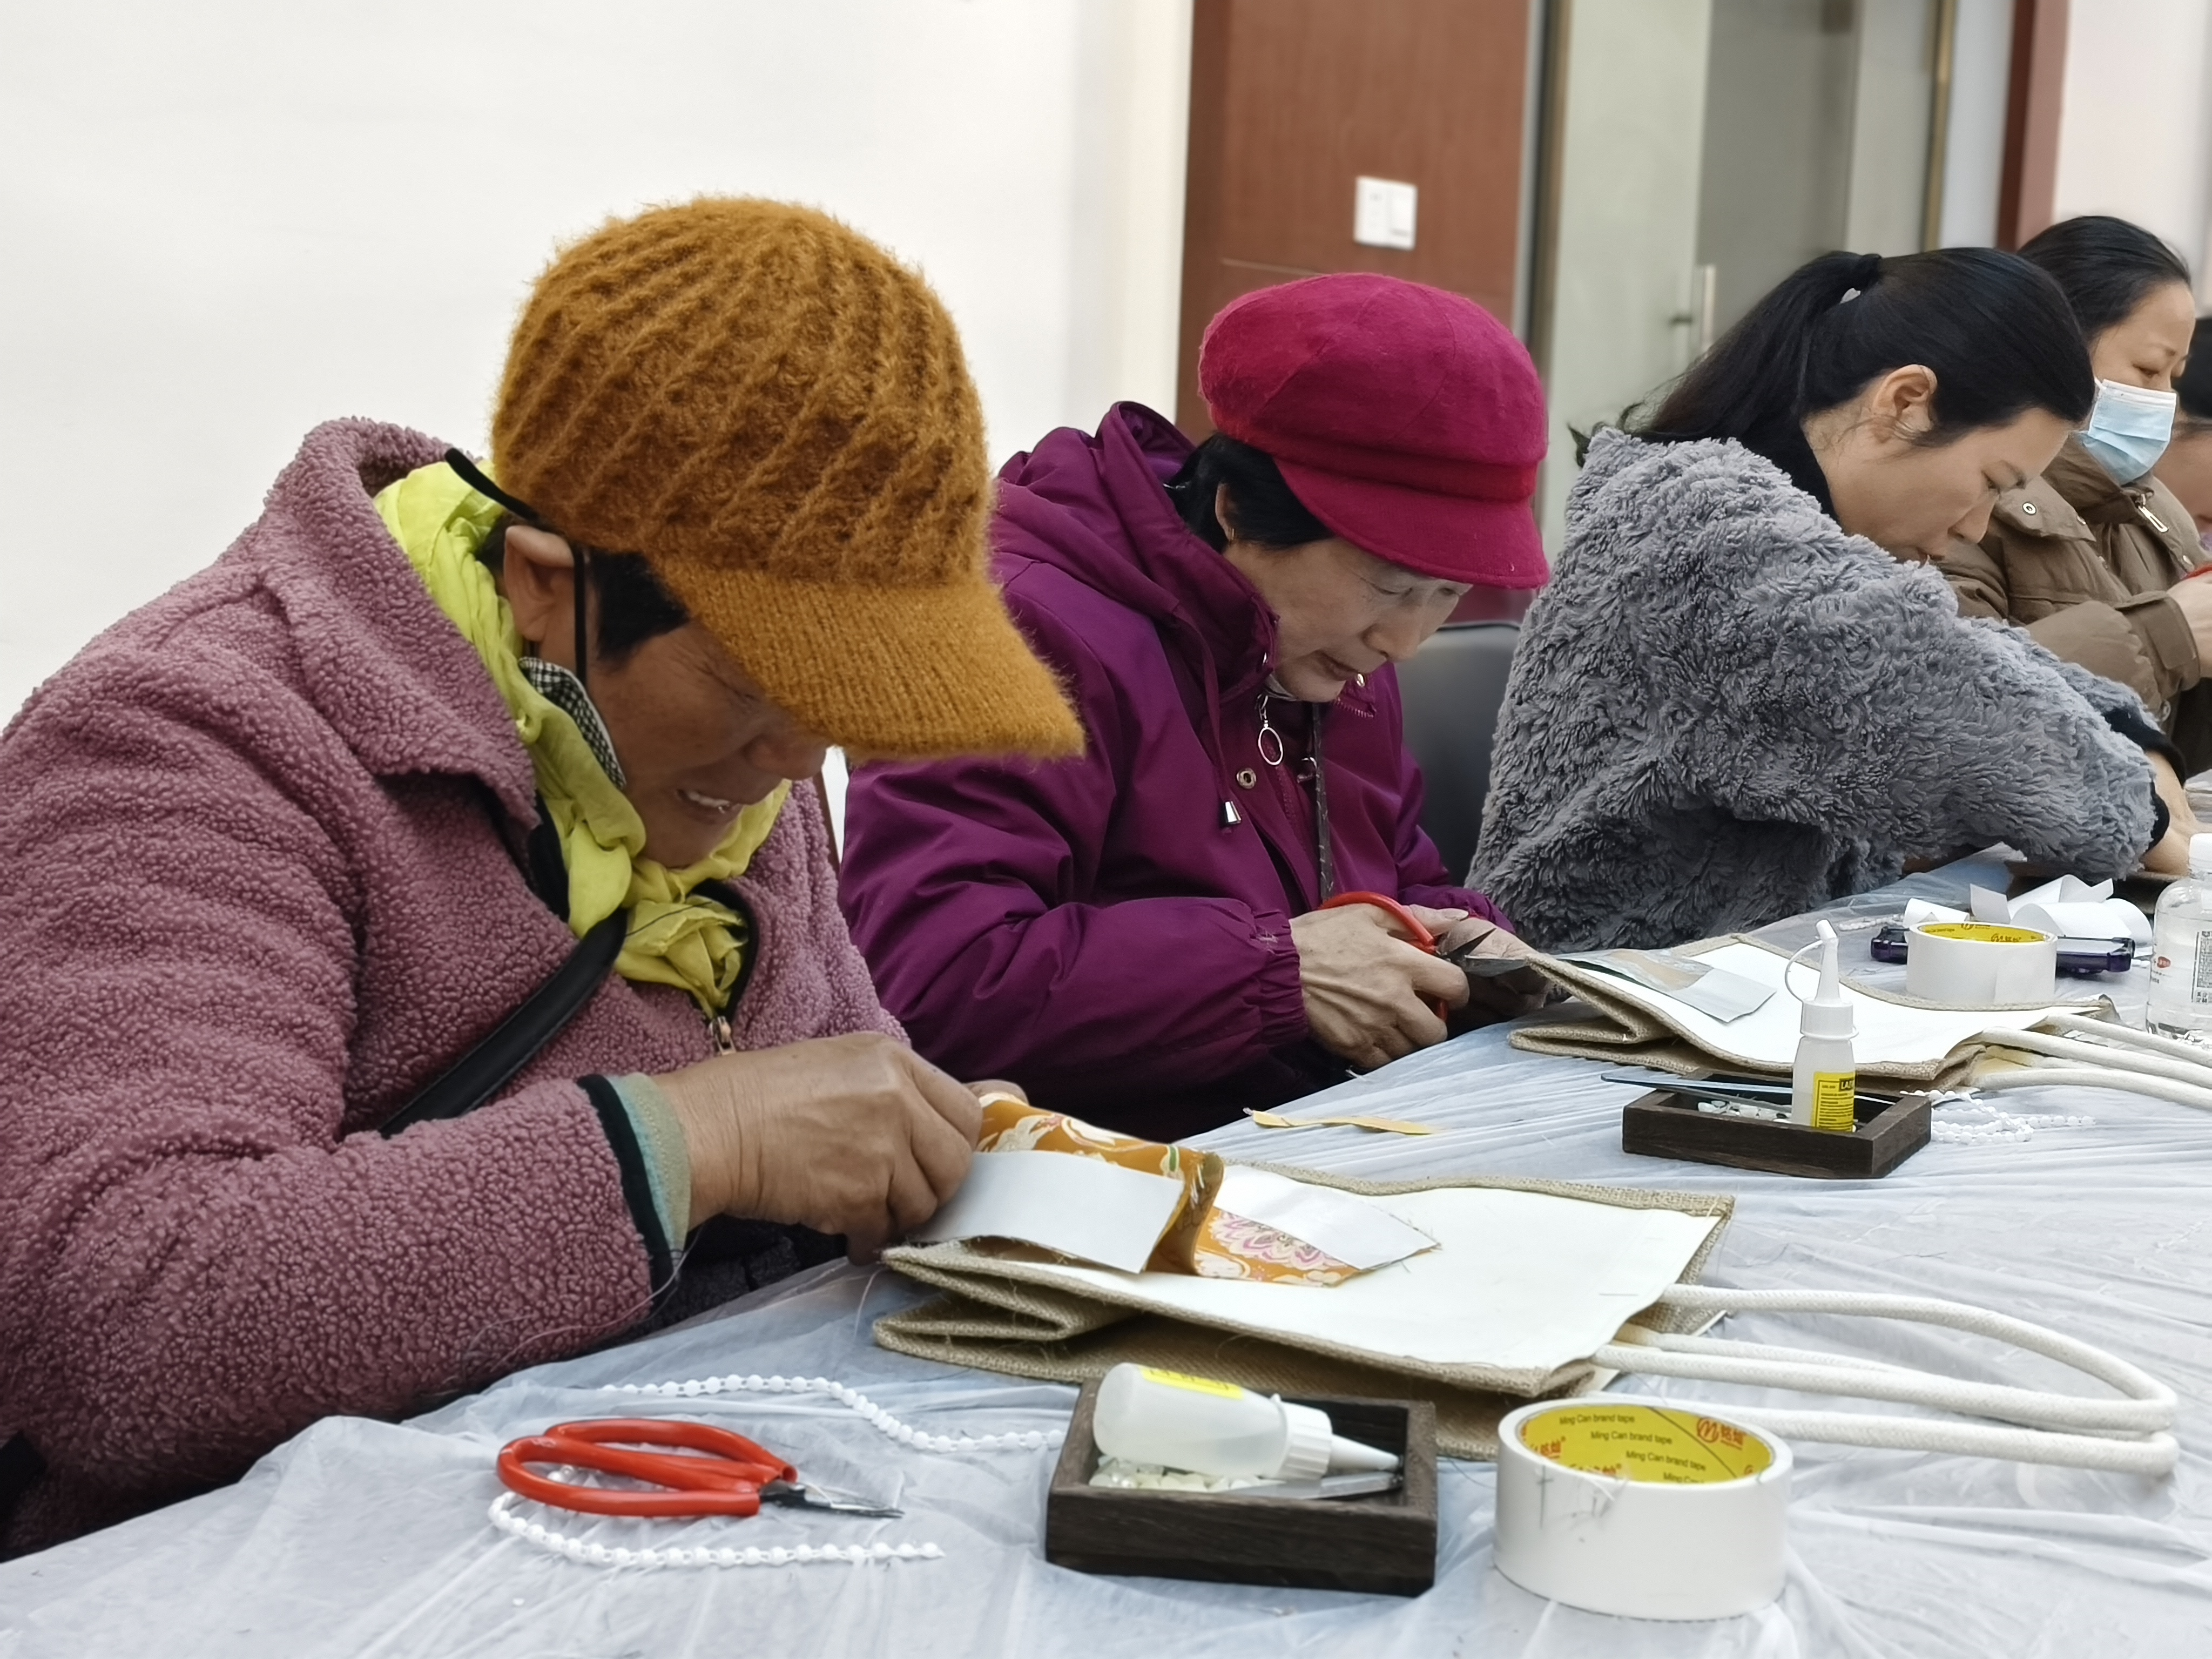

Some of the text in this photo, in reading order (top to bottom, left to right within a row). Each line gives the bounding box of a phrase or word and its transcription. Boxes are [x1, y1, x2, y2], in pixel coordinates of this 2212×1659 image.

[1560, 1414, 1635, 1425] Ming Can brand tape
[1590, 1431, 1672, 1445] Ming Can brand tape
[1626, 1450, 1705, 1471] Ming Can brand tape
